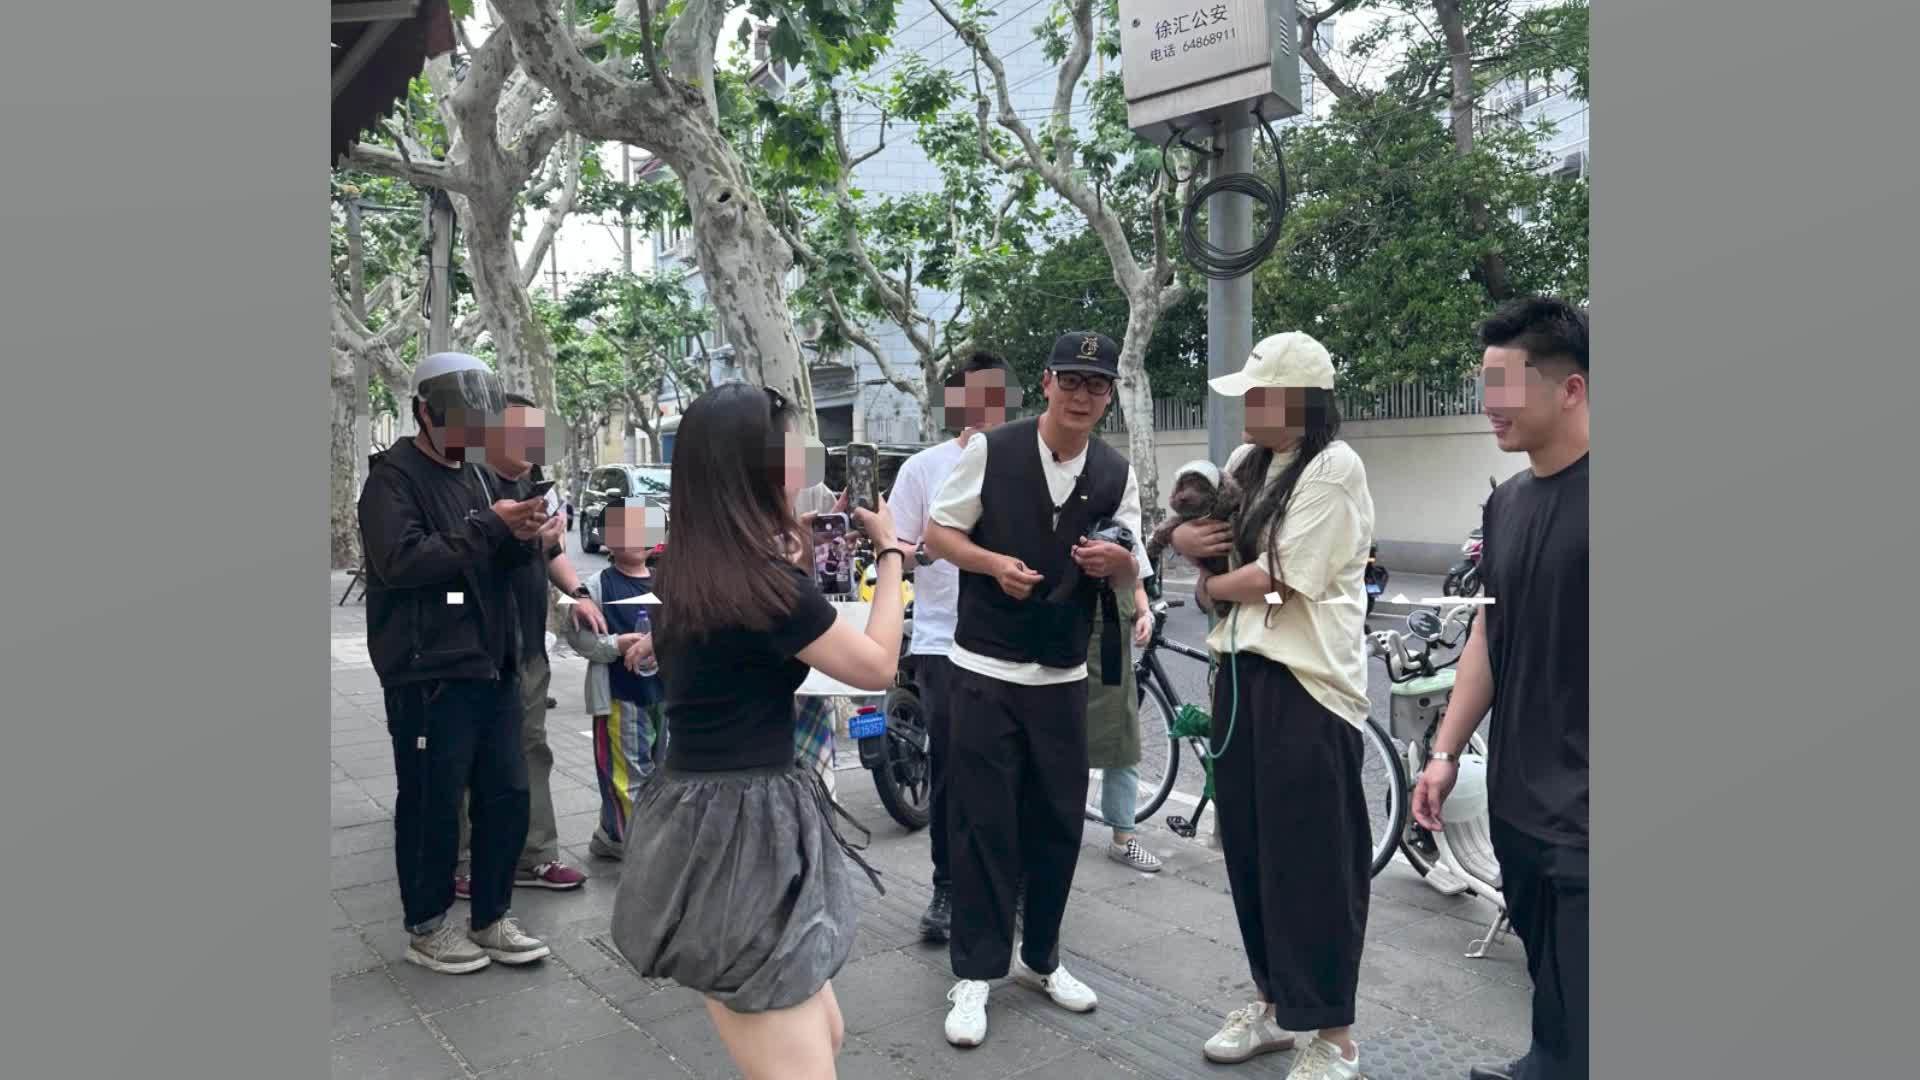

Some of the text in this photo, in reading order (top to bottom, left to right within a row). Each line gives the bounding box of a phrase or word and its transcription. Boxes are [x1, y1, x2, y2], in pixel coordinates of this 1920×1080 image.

[1155, 4, 1228, 41] 徐汇公安
[1150, 27, 1237, 62] 电话 64868911
